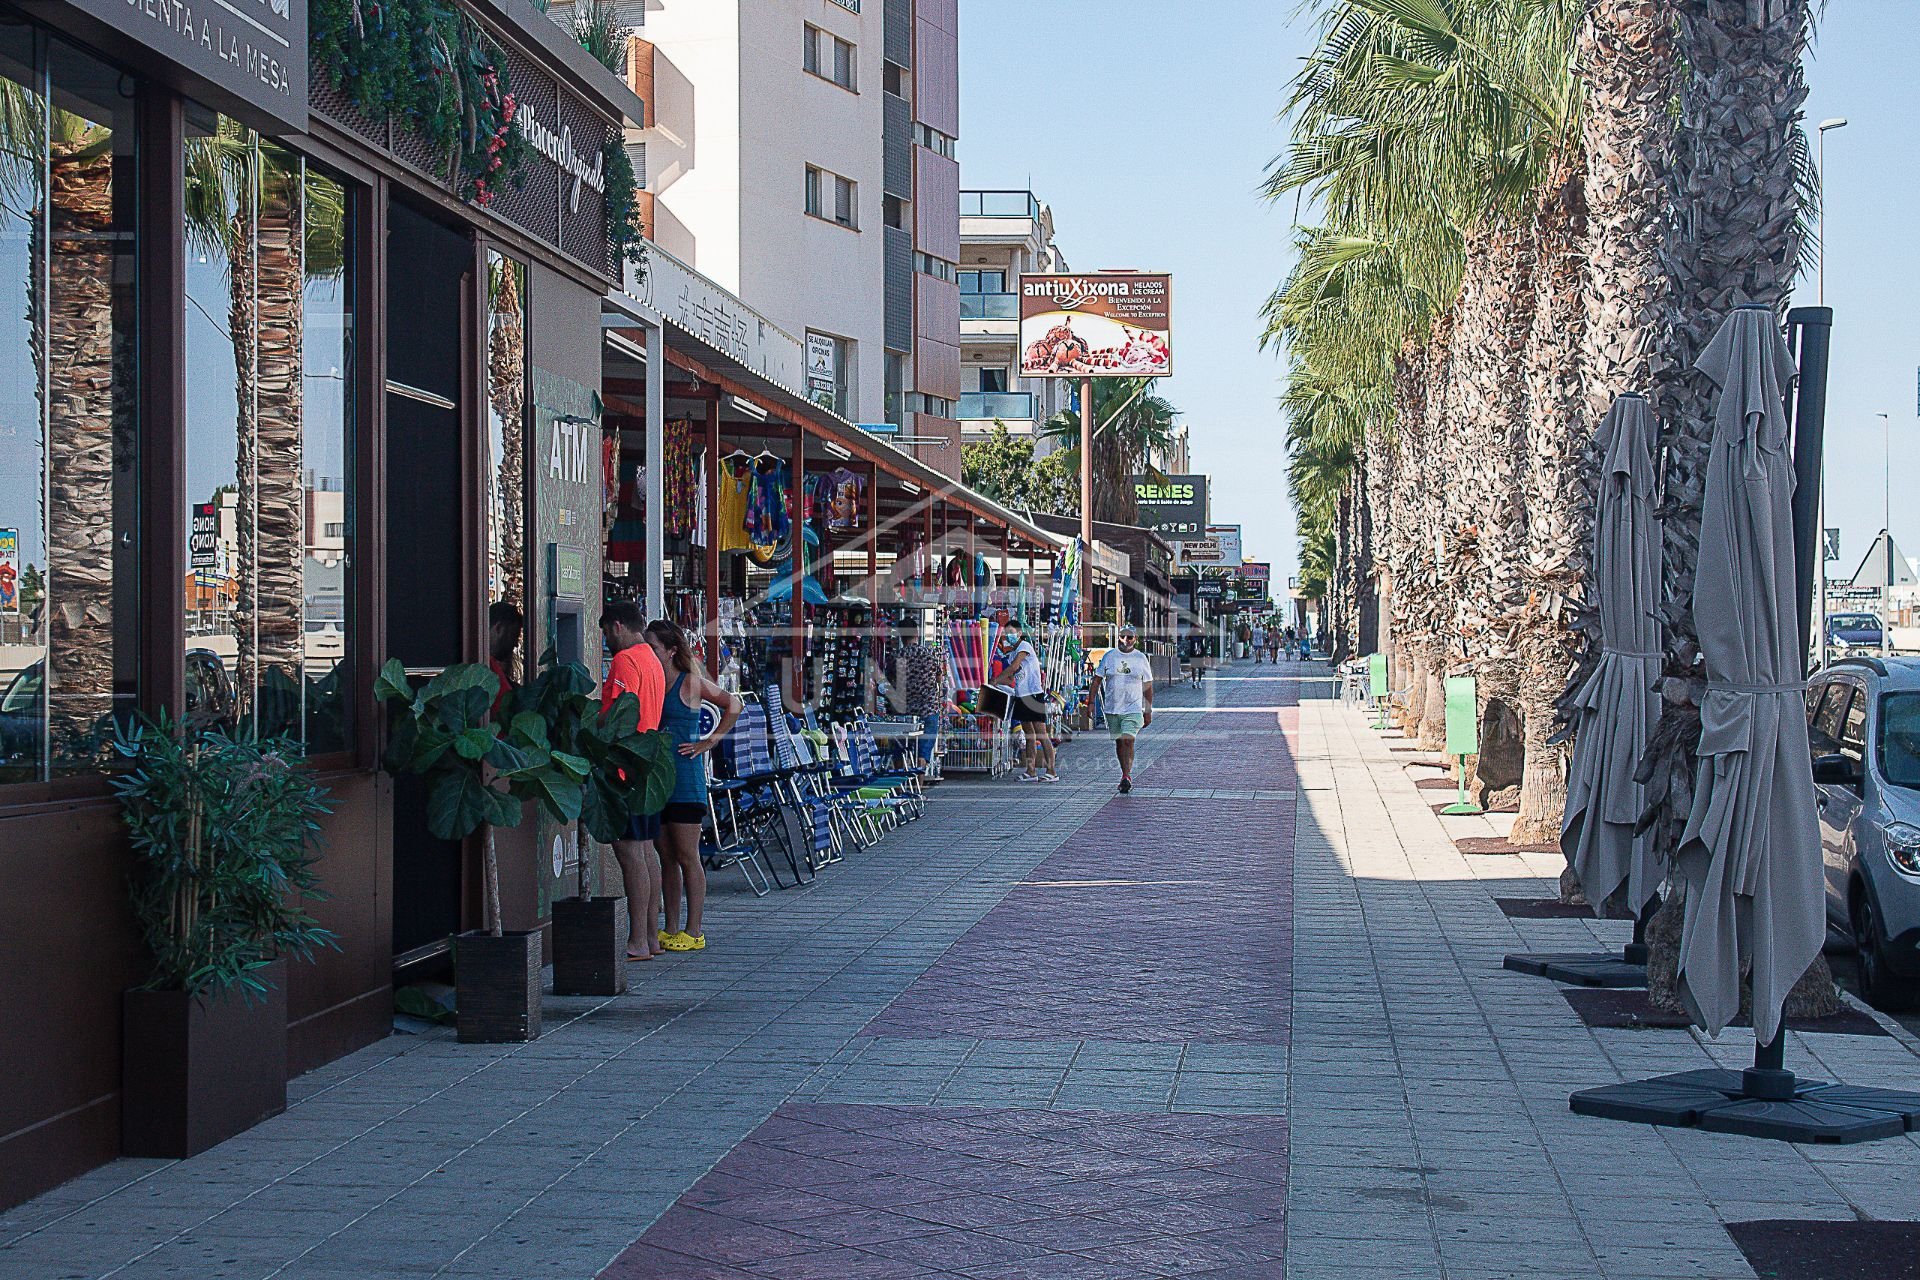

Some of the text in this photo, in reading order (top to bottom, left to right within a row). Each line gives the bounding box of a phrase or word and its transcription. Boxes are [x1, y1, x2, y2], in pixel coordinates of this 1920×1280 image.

[200, 19, 212, 51] A
[219, 27, 241, 68] LA
[246, 44, 291, 96] MESA
[1024, 278, 1129, 299] antiuXixona
[808, 336, 814, 344] SE
[549, 421, 588, 484] ATM
